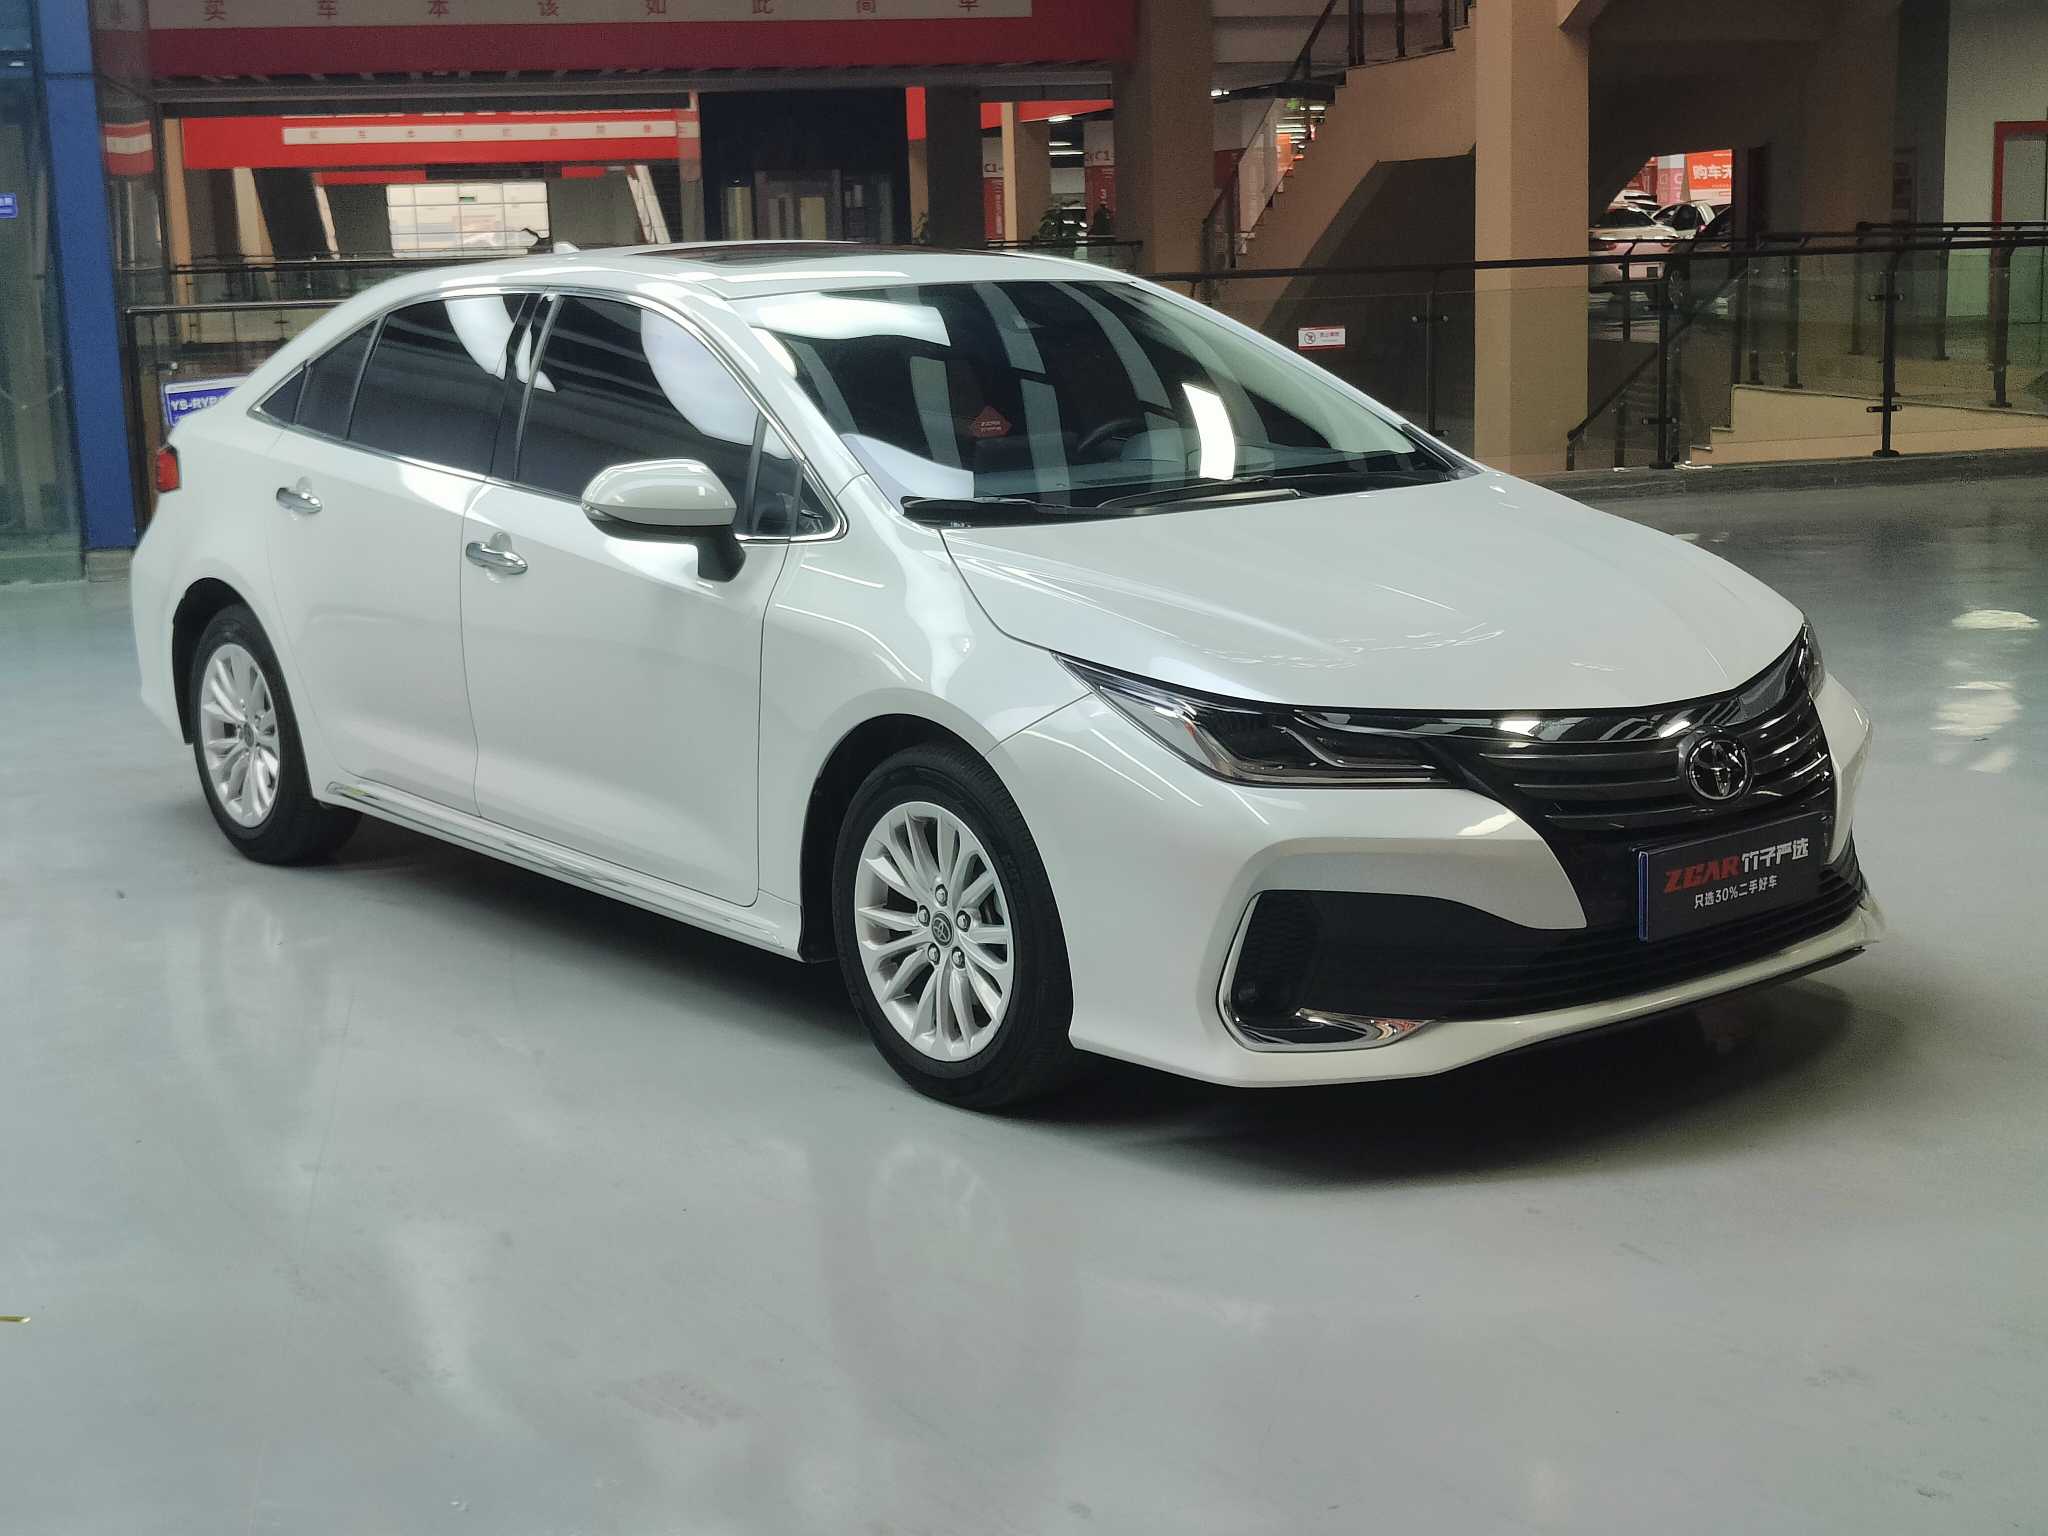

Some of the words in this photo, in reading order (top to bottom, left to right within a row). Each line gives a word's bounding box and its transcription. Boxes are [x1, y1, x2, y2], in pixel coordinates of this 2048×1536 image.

[1663, 854, 1740, 893] ZCAR
[1693, 874, 1778, 909] 只选30%二手好车
